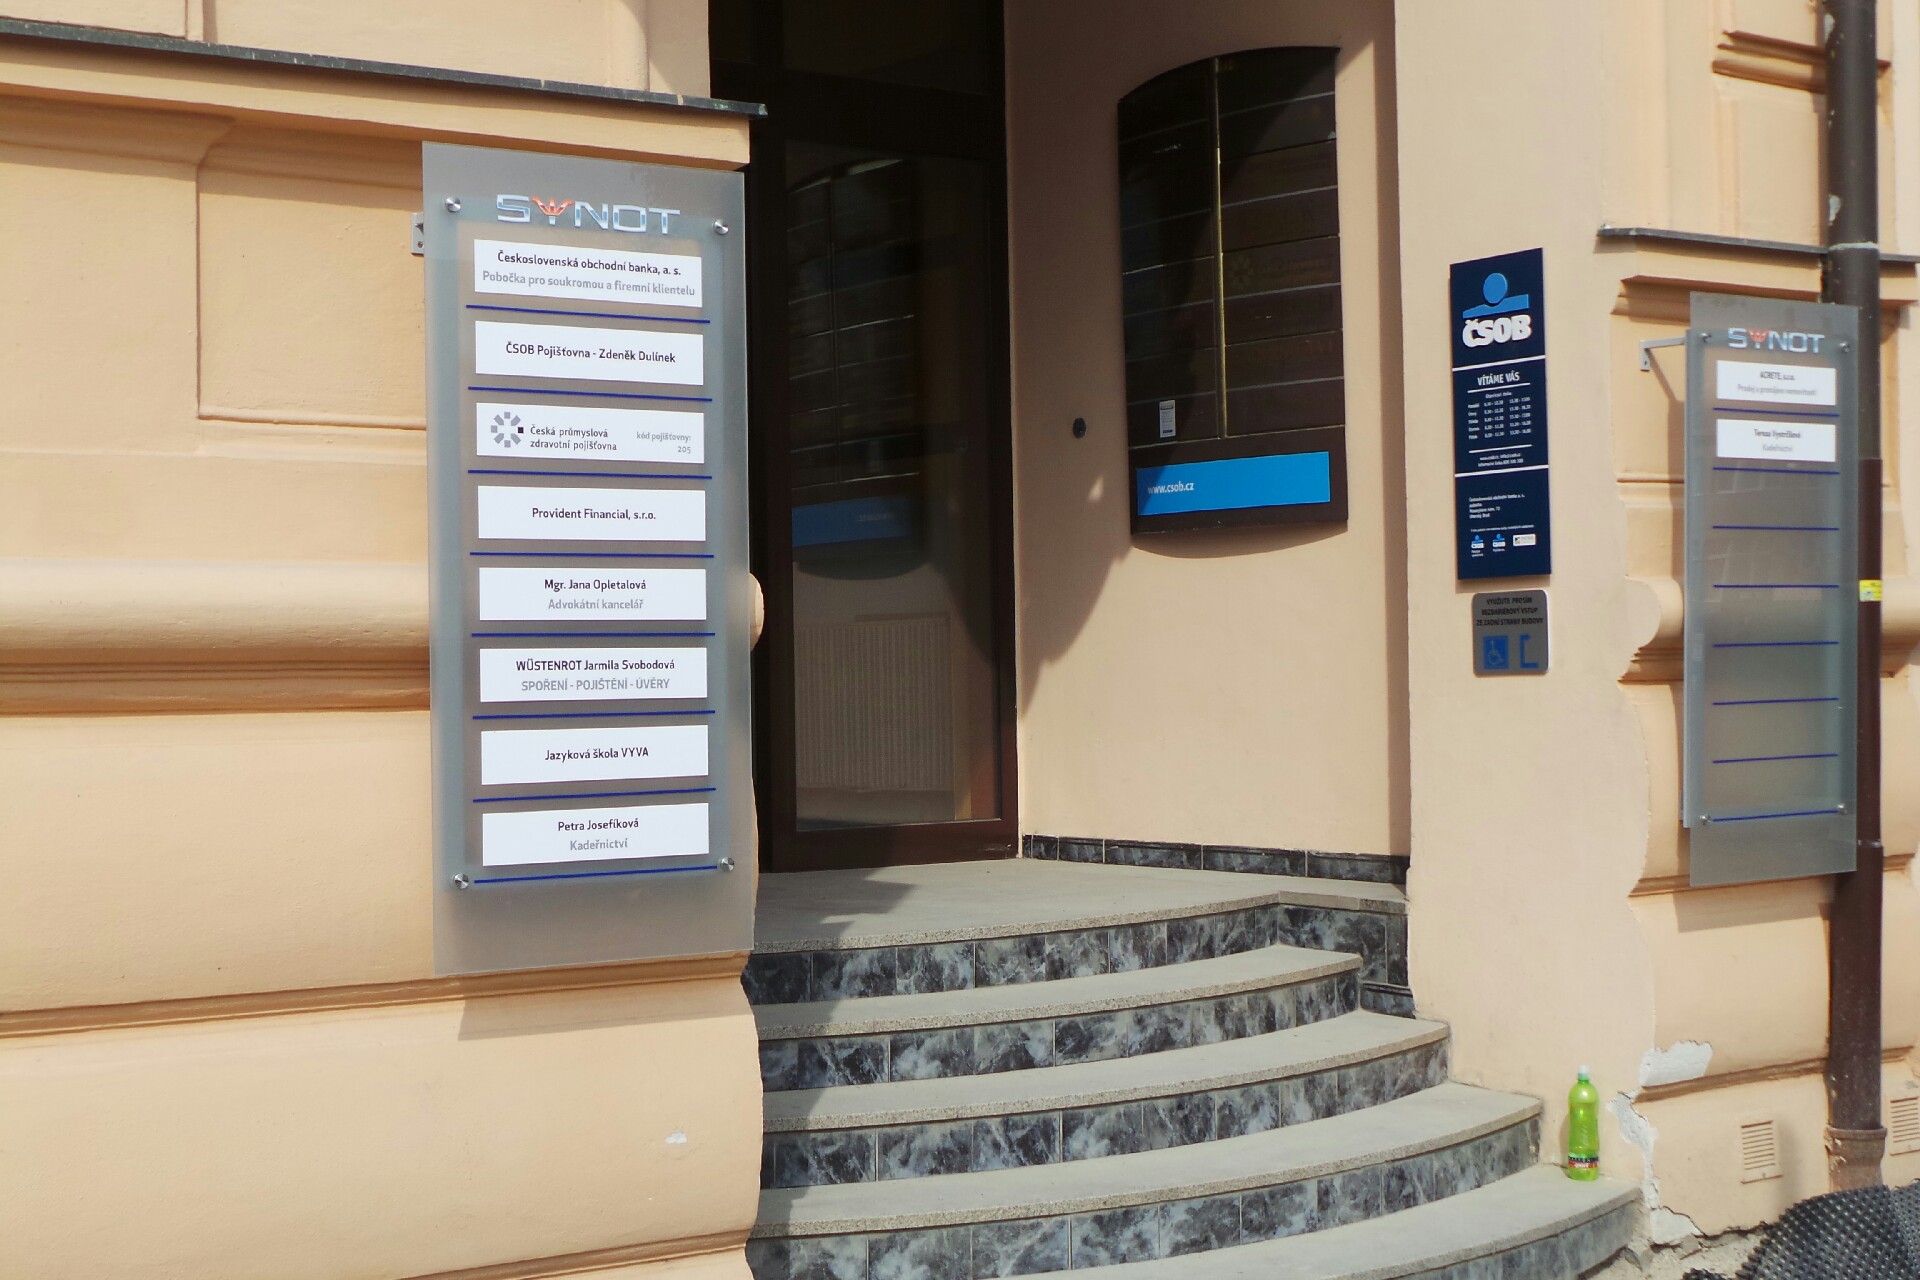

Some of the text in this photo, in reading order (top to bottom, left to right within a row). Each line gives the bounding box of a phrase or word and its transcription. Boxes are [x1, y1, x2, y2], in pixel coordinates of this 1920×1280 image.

[496, 194, 680, 235] SYNOT
[498, 250, 578, 267] Československá
[581, 259, 626, 271] obchodní
[629, 262, 660, 275] banka,
[483, 270, 525, 283] Pobočka
[529, 277, 545, 287] pro
[548, 277, 603, 289] soukromou
[614, 280, 650, 292] firemní
[653, 283, 695, 295] klientelu
[1462, 314, 1532, 348] ČSOB
[1728, 328, 1825, 353] SYNOT
[506, 341, 534, 354] ČSOB
[538, 345, 590, 358] Pojišťovna
[599, 349, 636, 360] Zdeněk
[639, 351, 675, 362] Dulínek
[1477, 370, 1520, 386] VÍTÁME VÁS
[530, 424, 608, 438] Česká průmyslová
[530, 439, 617, 451] zdravotní pojišťovna
[678, 446, 691, 454] 205
[1148, 481, 1195, 494] www.csob.cz
[533, 508, 581, 518] Provident
[584, 509, 630, 520] Financial,
[545, 579, 646, 592] Mgr. Jana Opletalová
[548, 599, 643, 609] Advokátní kancelář
[516, 658, 674, 671] WÜSTENROT Jarmila Svobodová
[522, 678, 568, 691] SPOŘENÍ
[577, 678, 627, 690] POJIŠTĚNÍ
[636, 677, 670, 689] ÚVĚRY
[545, 747, 648, 763] Jazyková škola VYVA
[558, 818, 638, 831] Petra Josefíková
[570, 838, 628, 850] Kadeřnictví
